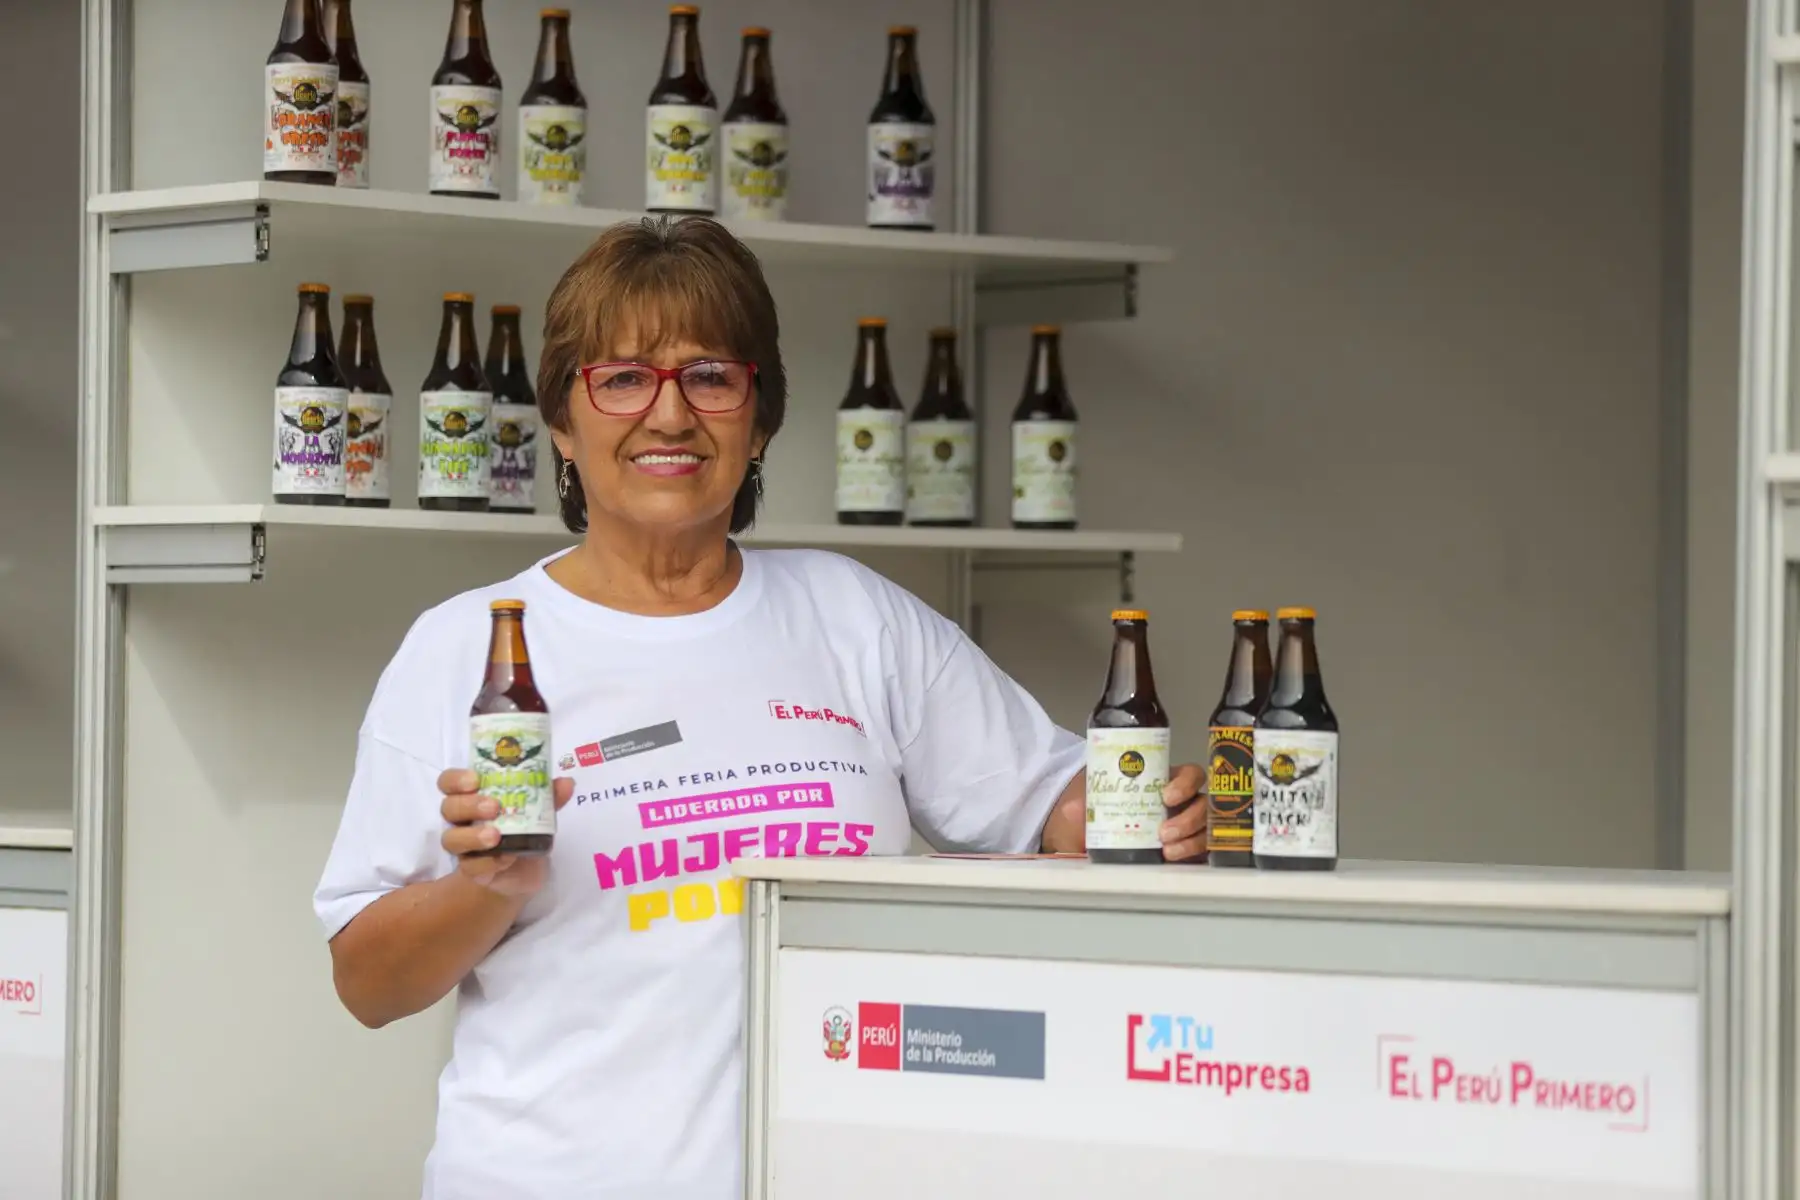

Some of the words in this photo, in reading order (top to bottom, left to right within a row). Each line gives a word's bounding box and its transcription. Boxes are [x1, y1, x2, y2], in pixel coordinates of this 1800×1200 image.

[775, 705, 793, 720] EL
[577, 779, 669, 806] PRIMERA
[678, 769, 737, 787] FERIA
[747, 761, 868, 778] PRODUCTIVA
[648, 793, 768, 822] LIDERADA
[776, 787, 825, 804] POR
[593, 821, 874, 890] MUJERES
[862, 1023, 897, 1047] PERÚ
[906, 1028, 963, 1048] Ministerio
[1176, 1016, 1213, 1050] Tu
[906, 1047, 920, 1062] de
[923, 1047, 933, 1063] la
[934, 1046, 996, 1068] Producción
[1175, 1052, 1310, 1097] Empresa
[1388, 1054, 1423, 1100] EL
[1431, 1056, 1502, 1105] PERÚ
[1509, 1061, 1637, 1114] PRIMERO
